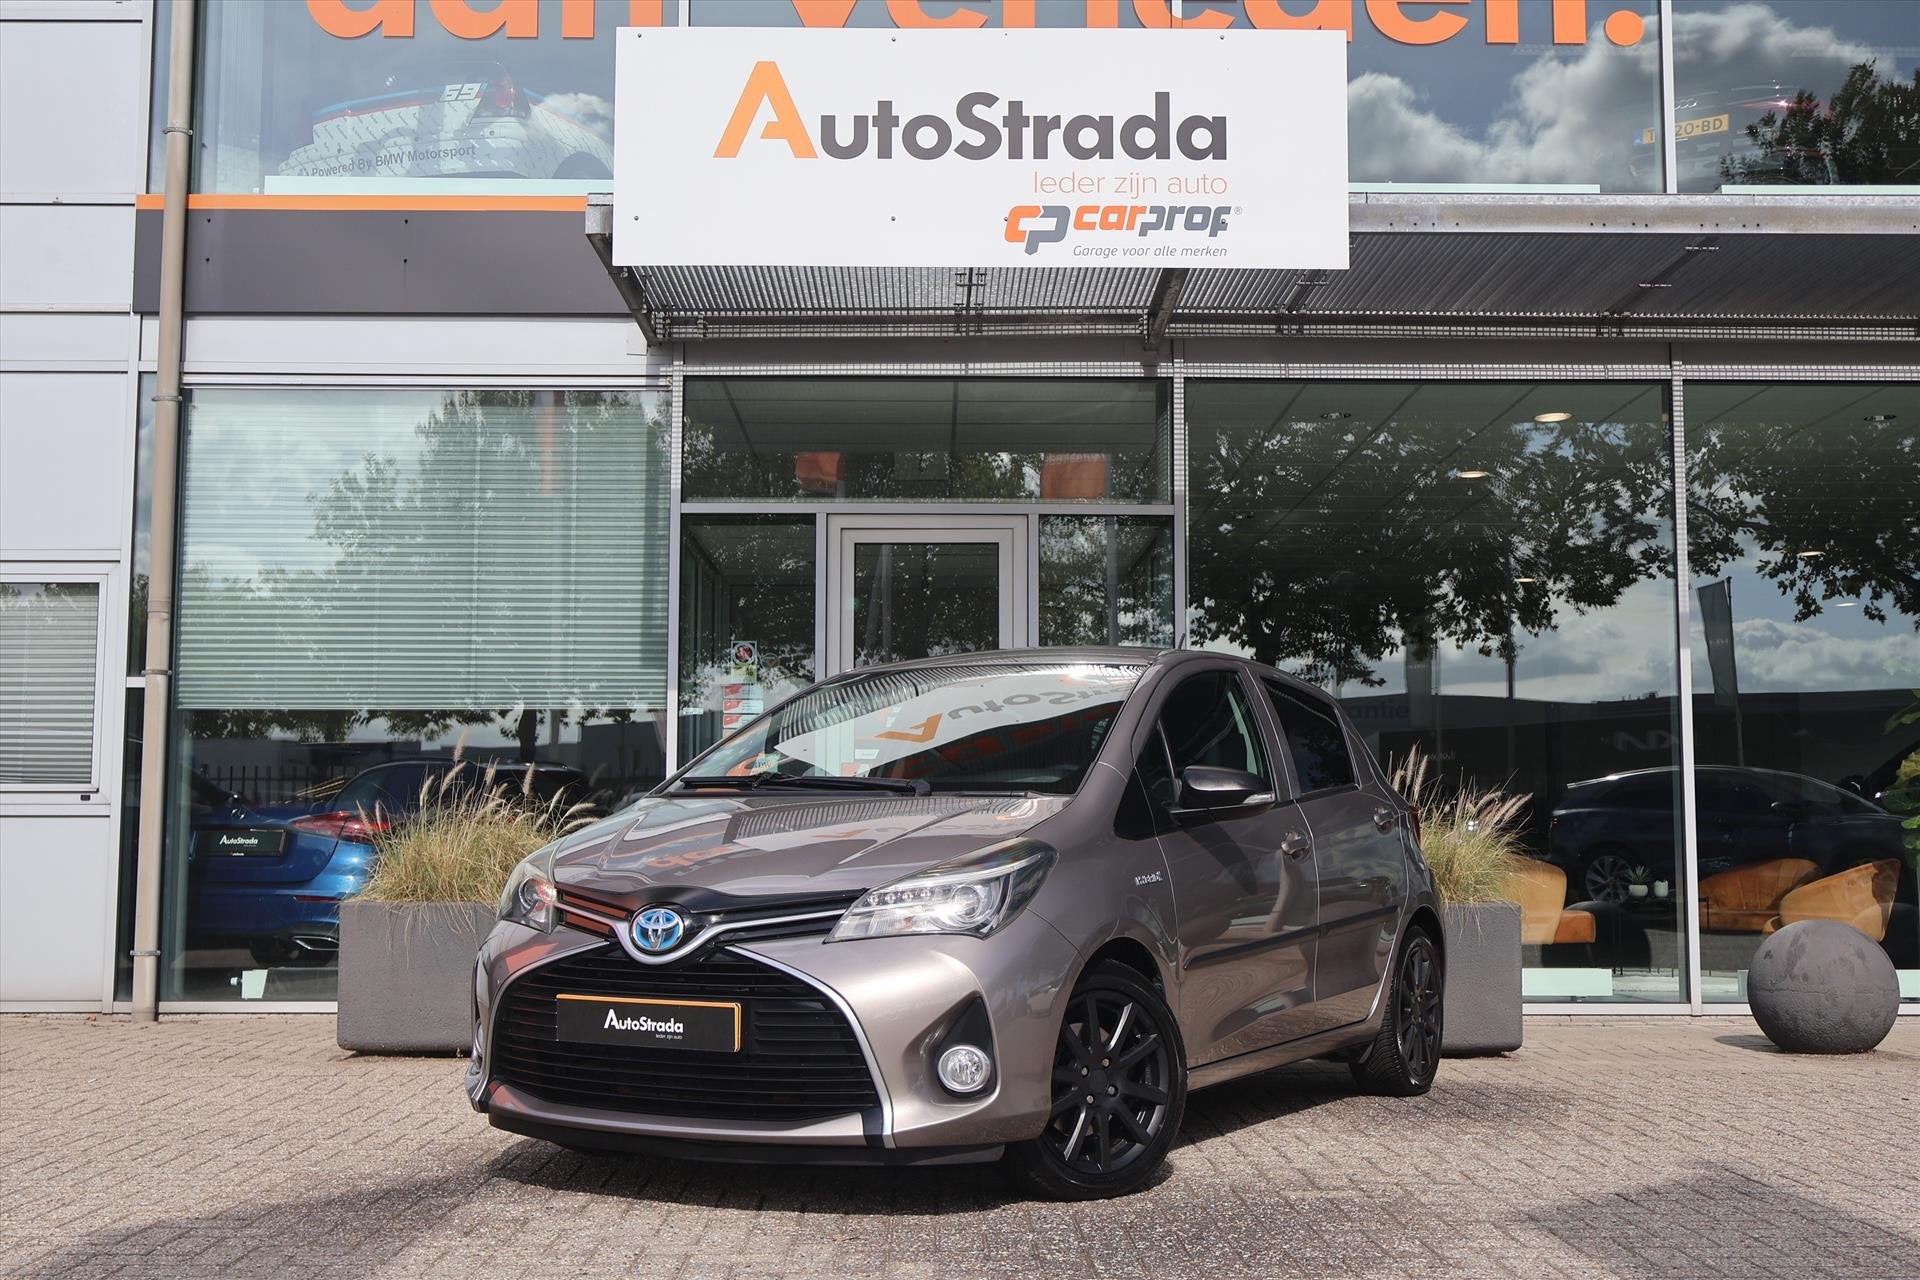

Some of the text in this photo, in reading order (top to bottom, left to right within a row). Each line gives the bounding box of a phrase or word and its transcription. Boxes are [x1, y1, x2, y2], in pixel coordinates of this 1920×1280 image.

[712, 60, 1228, 160] AutoStrada
[357, 158, 372, 172] By
[375, 151, 404, 167] BMW
[408, 145, 475, 162] Motorsport
[1033, 171, 1229, 200] Ieder zijn auto
[1072, 244, 1228, 260] Garage voor alle merken
[603, 1008, 684, 1033] AutoStrada
